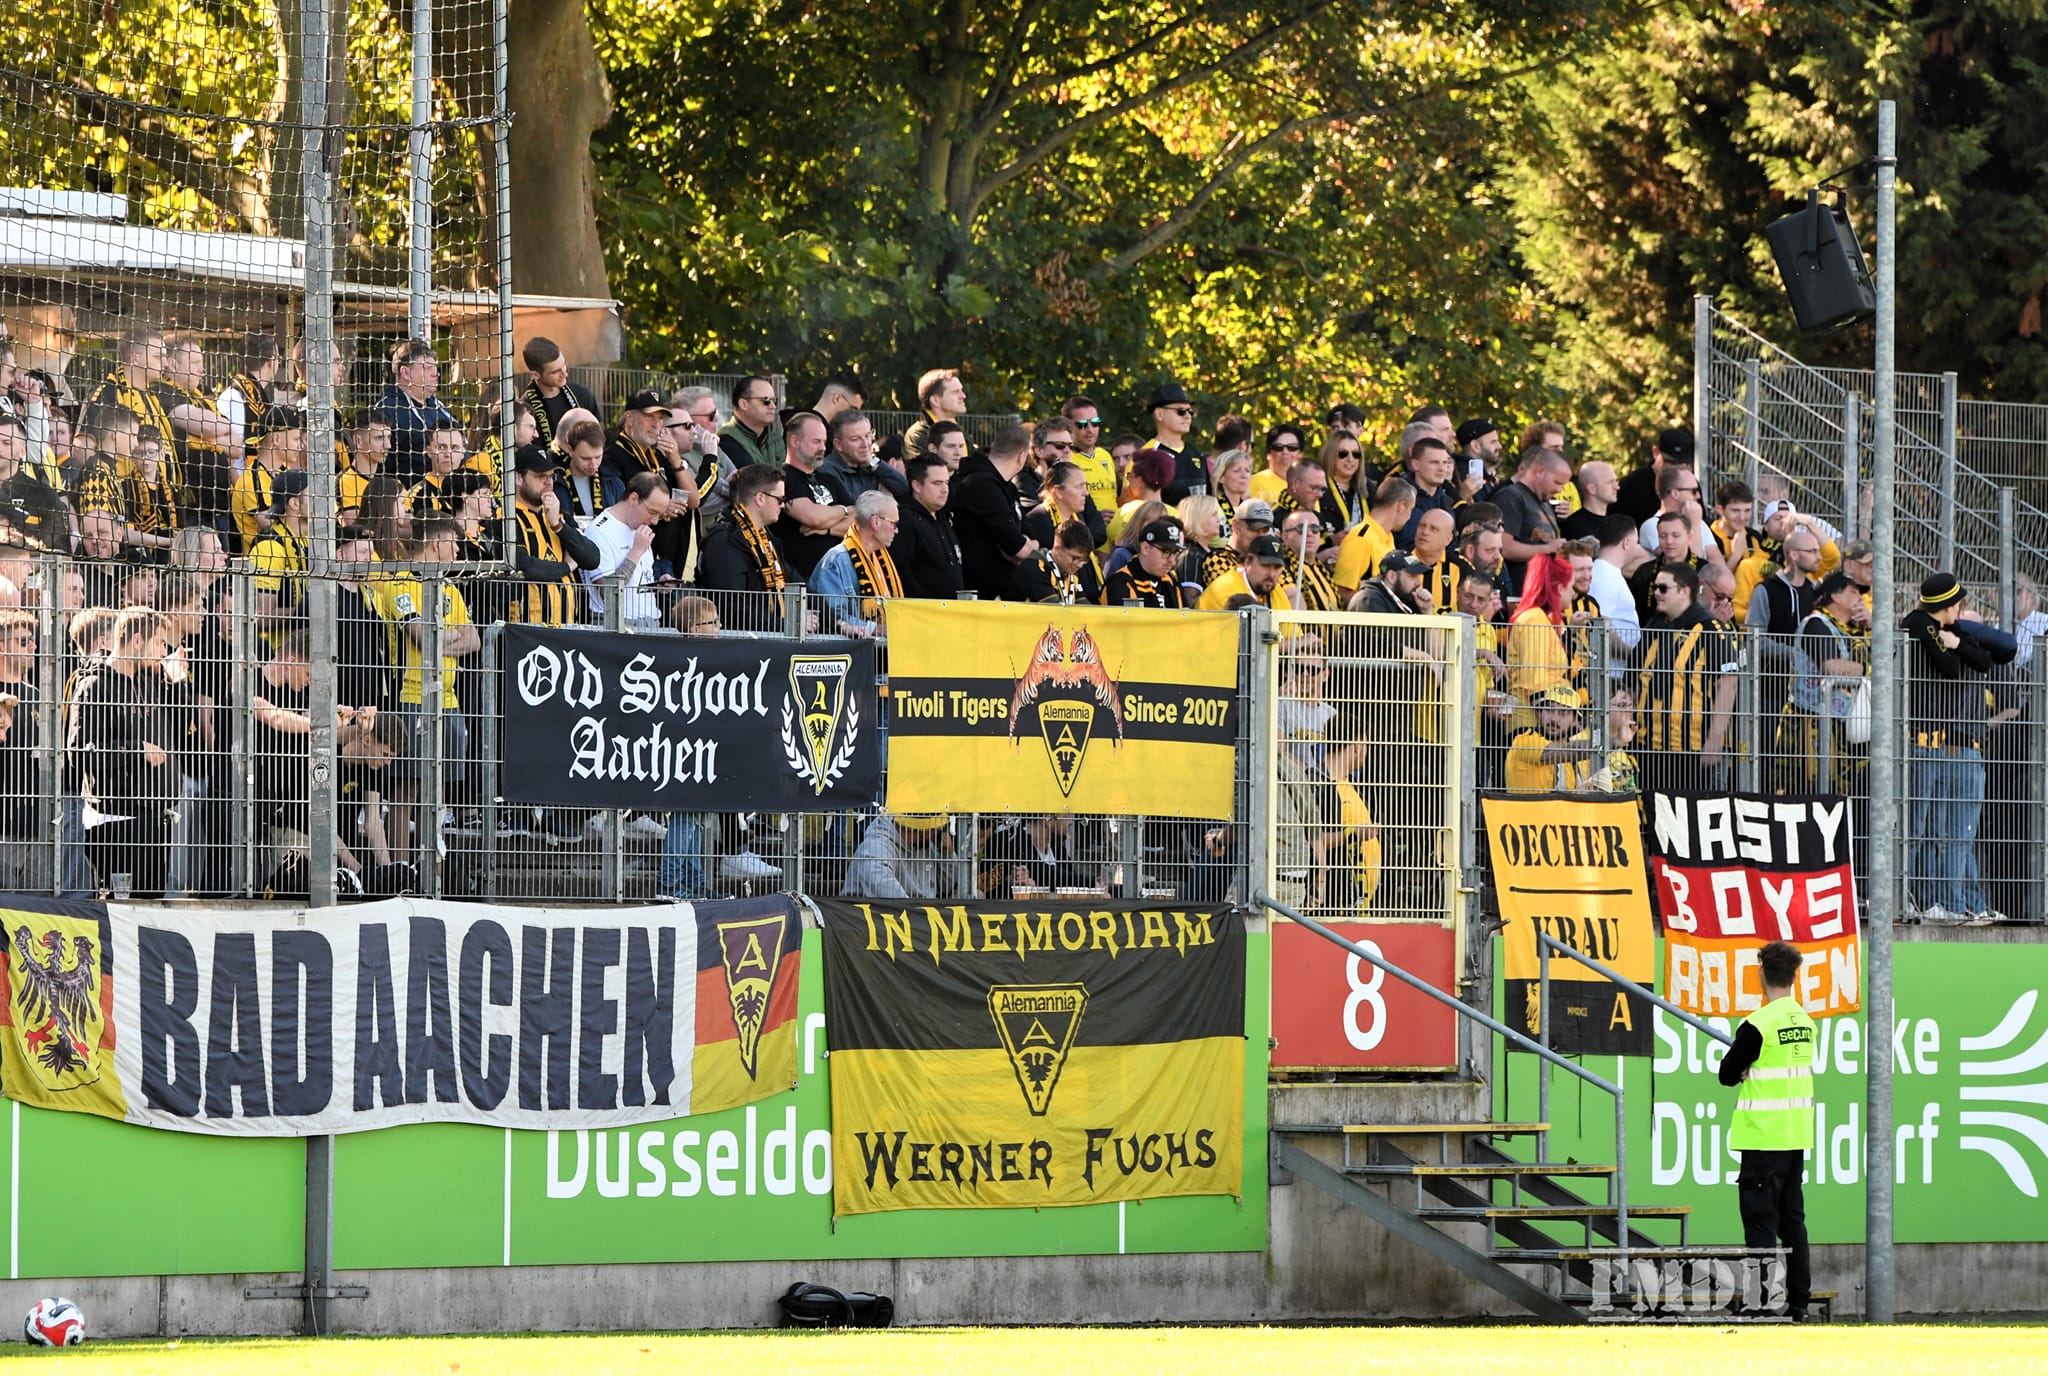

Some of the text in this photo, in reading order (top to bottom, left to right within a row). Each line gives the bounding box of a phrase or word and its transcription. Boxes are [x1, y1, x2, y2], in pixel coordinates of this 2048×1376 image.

[518, 645, 770, 724] Old School
[795, 663, 843, 675] ALEMANNIA
[894, 690, 1008, 726] Tivoli Tigers
[1043, 704, 1090, 719] Alemannia
[1056, 723, 1077, 746] A
[1124, 694, 1229, 726] Since 2007
[569, 715, 718, 791] Aachen
[1499, 823, 1630, 868] OECHER
[1653, 791, 1845, 865] NASTY
[1661, 864, 1844, 940] BOYS
[854, 903, 1216, 966] IN MEMORIAM
[1001, 992, 1076, 1012] Alemannia
[1343, 939, 1388, 1051] 8
[1669, 943, 1858, 1013] AACEN
[138, 916, 676, 1119] BAD AACHEN
[1021, 1017, 1056, 1045] A
[1609, 992, 1633, 1031] A
[853, 1126, 1217, 1194] WERNER FUCHS
